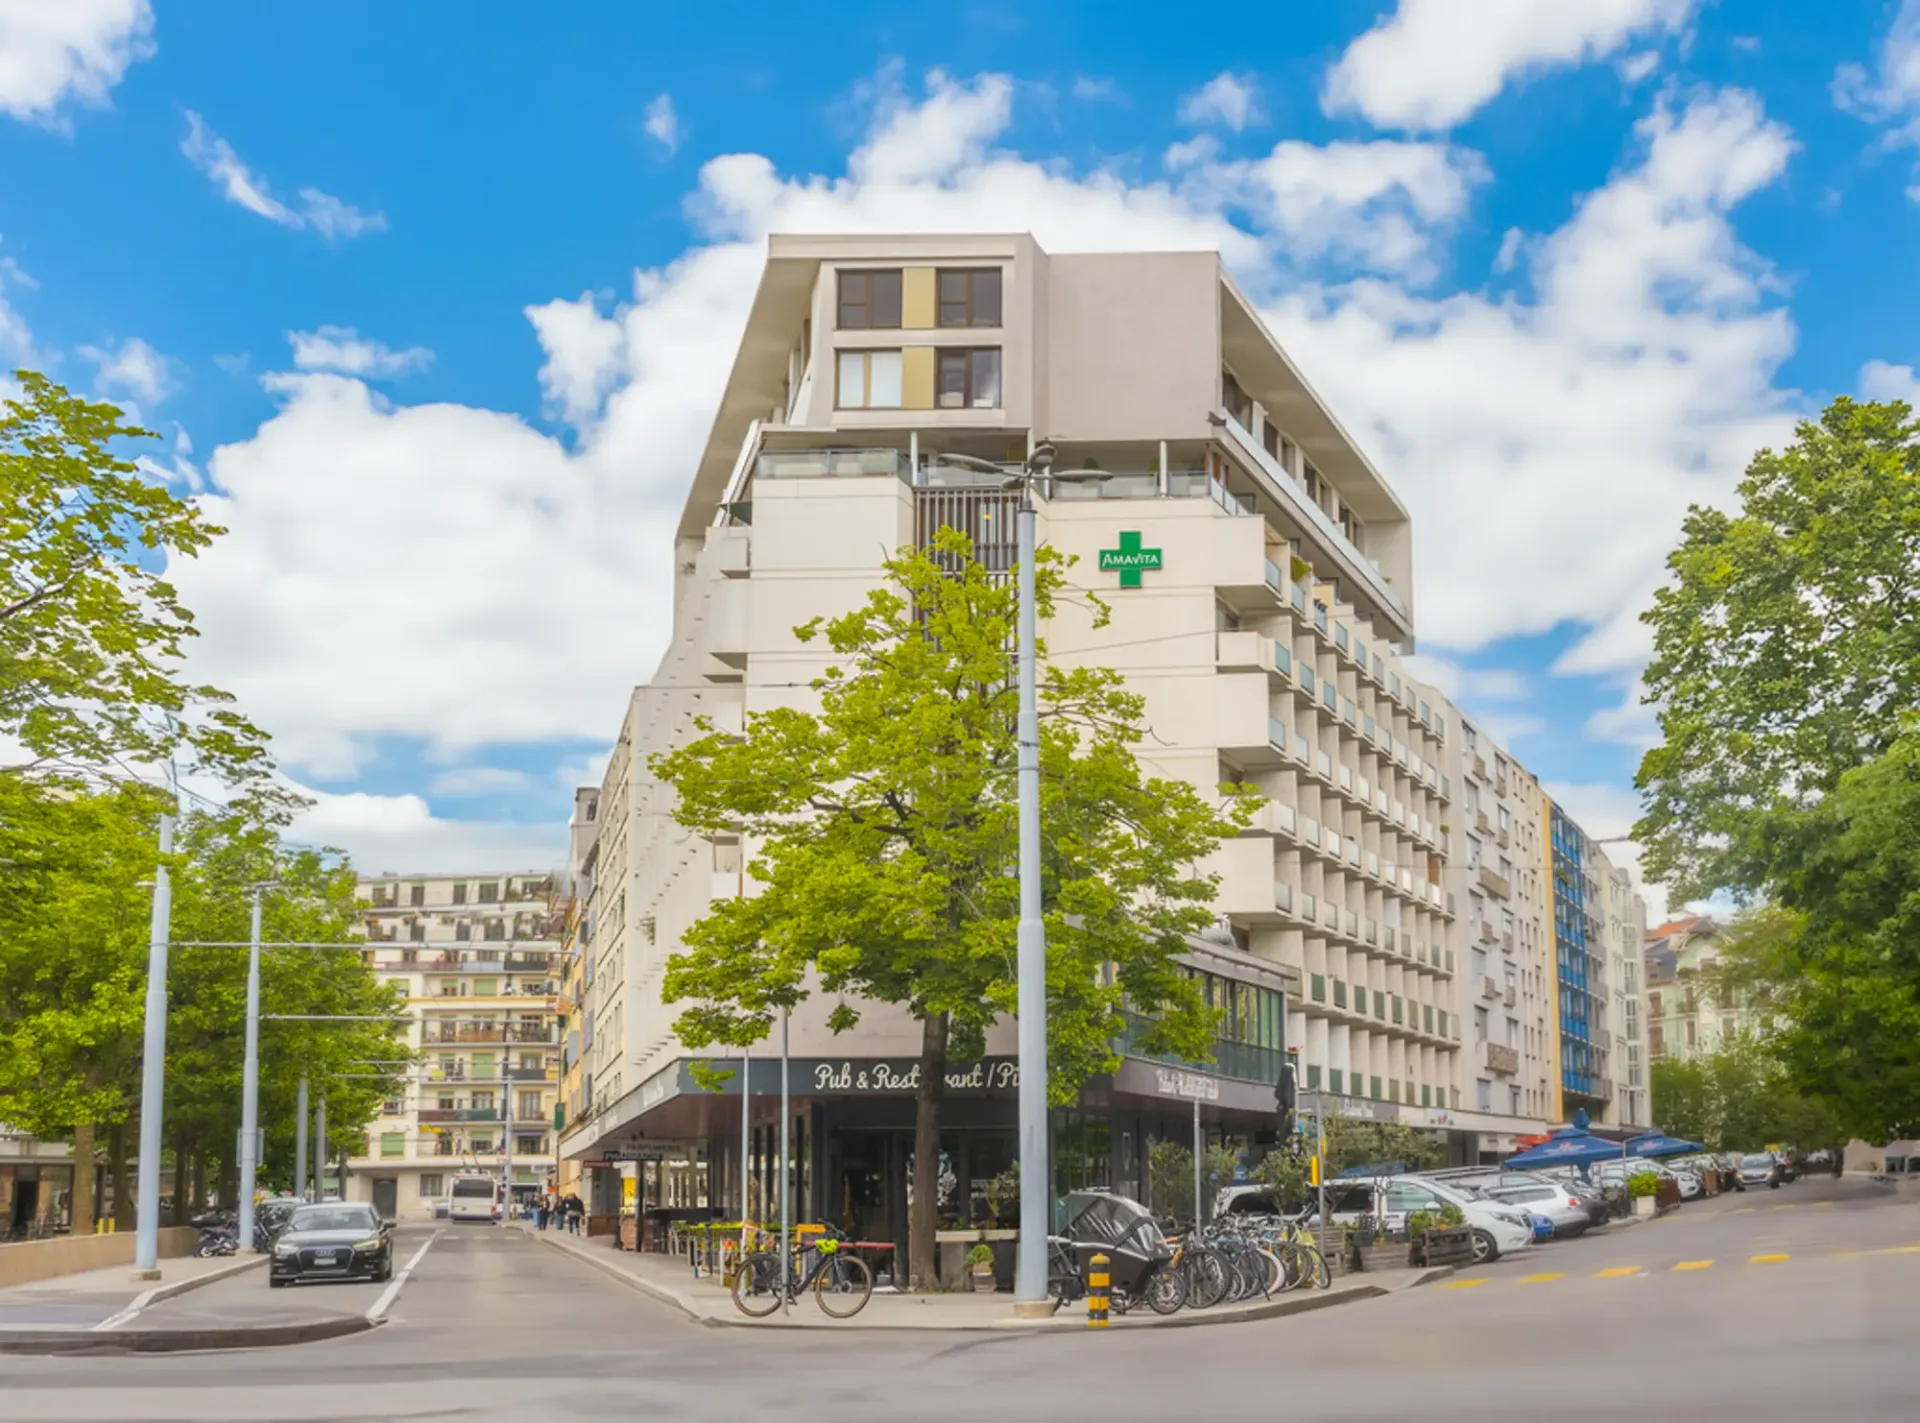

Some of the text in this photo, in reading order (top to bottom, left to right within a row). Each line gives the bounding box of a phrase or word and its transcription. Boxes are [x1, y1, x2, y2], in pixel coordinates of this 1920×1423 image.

[1102, 553, 1159, 567] AMAVITA
[815, 1062, 852, 1090] Pub
[856, 1071, 868, 1089] &
[872, 1063, 983, 1089] Restrant
[996, 1062, 1020, 1088] Pi
